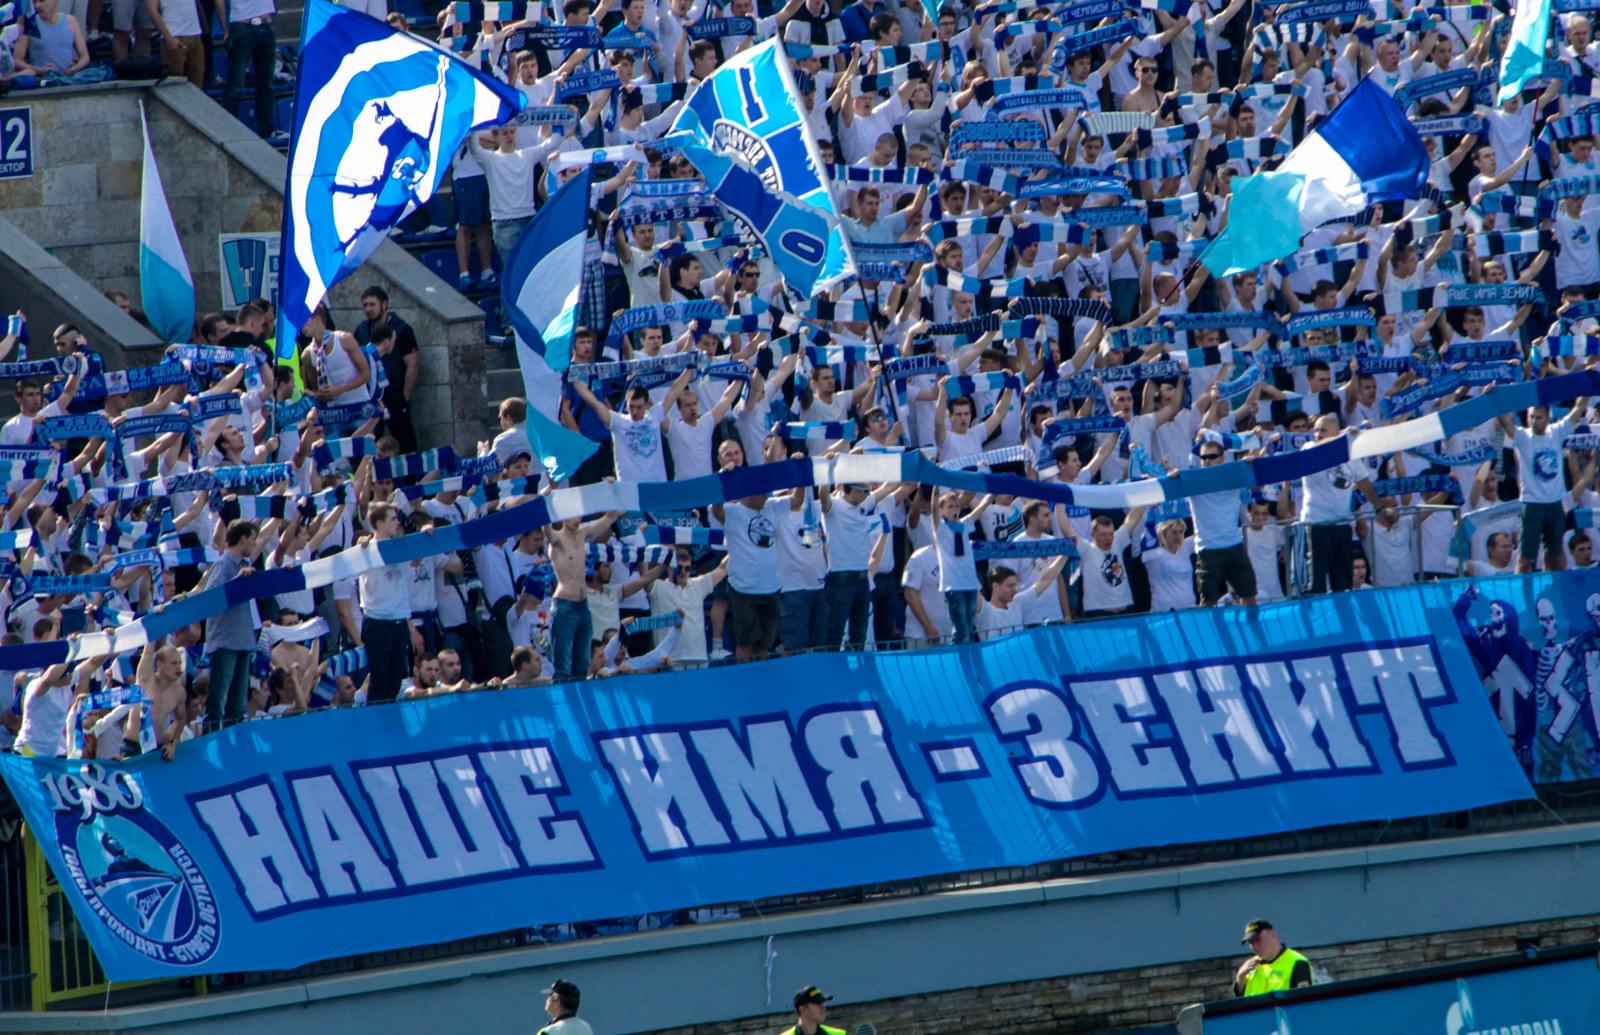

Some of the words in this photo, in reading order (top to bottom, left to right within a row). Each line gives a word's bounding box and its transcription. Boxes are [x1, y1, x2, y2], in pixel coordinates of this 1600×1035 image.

[0, 116, 27, 160] 2
[0, 161, 25, 174] ЕКТОР
[623, 207, 700, 224] ПИТЕР
[1474, 288, 1496, 299] ИМЯ
[1501, 286, 1535, 298] ЗЕНИТ
[1567, 434, 1600, 446] ZENI
[190, 743, 601, 917] НАШЕ
[596, 704, 929, 858] ИМЯ
[986, 639, 1452, 805] ЗЕНИТ
[41, 763, 143, 820] 1980
